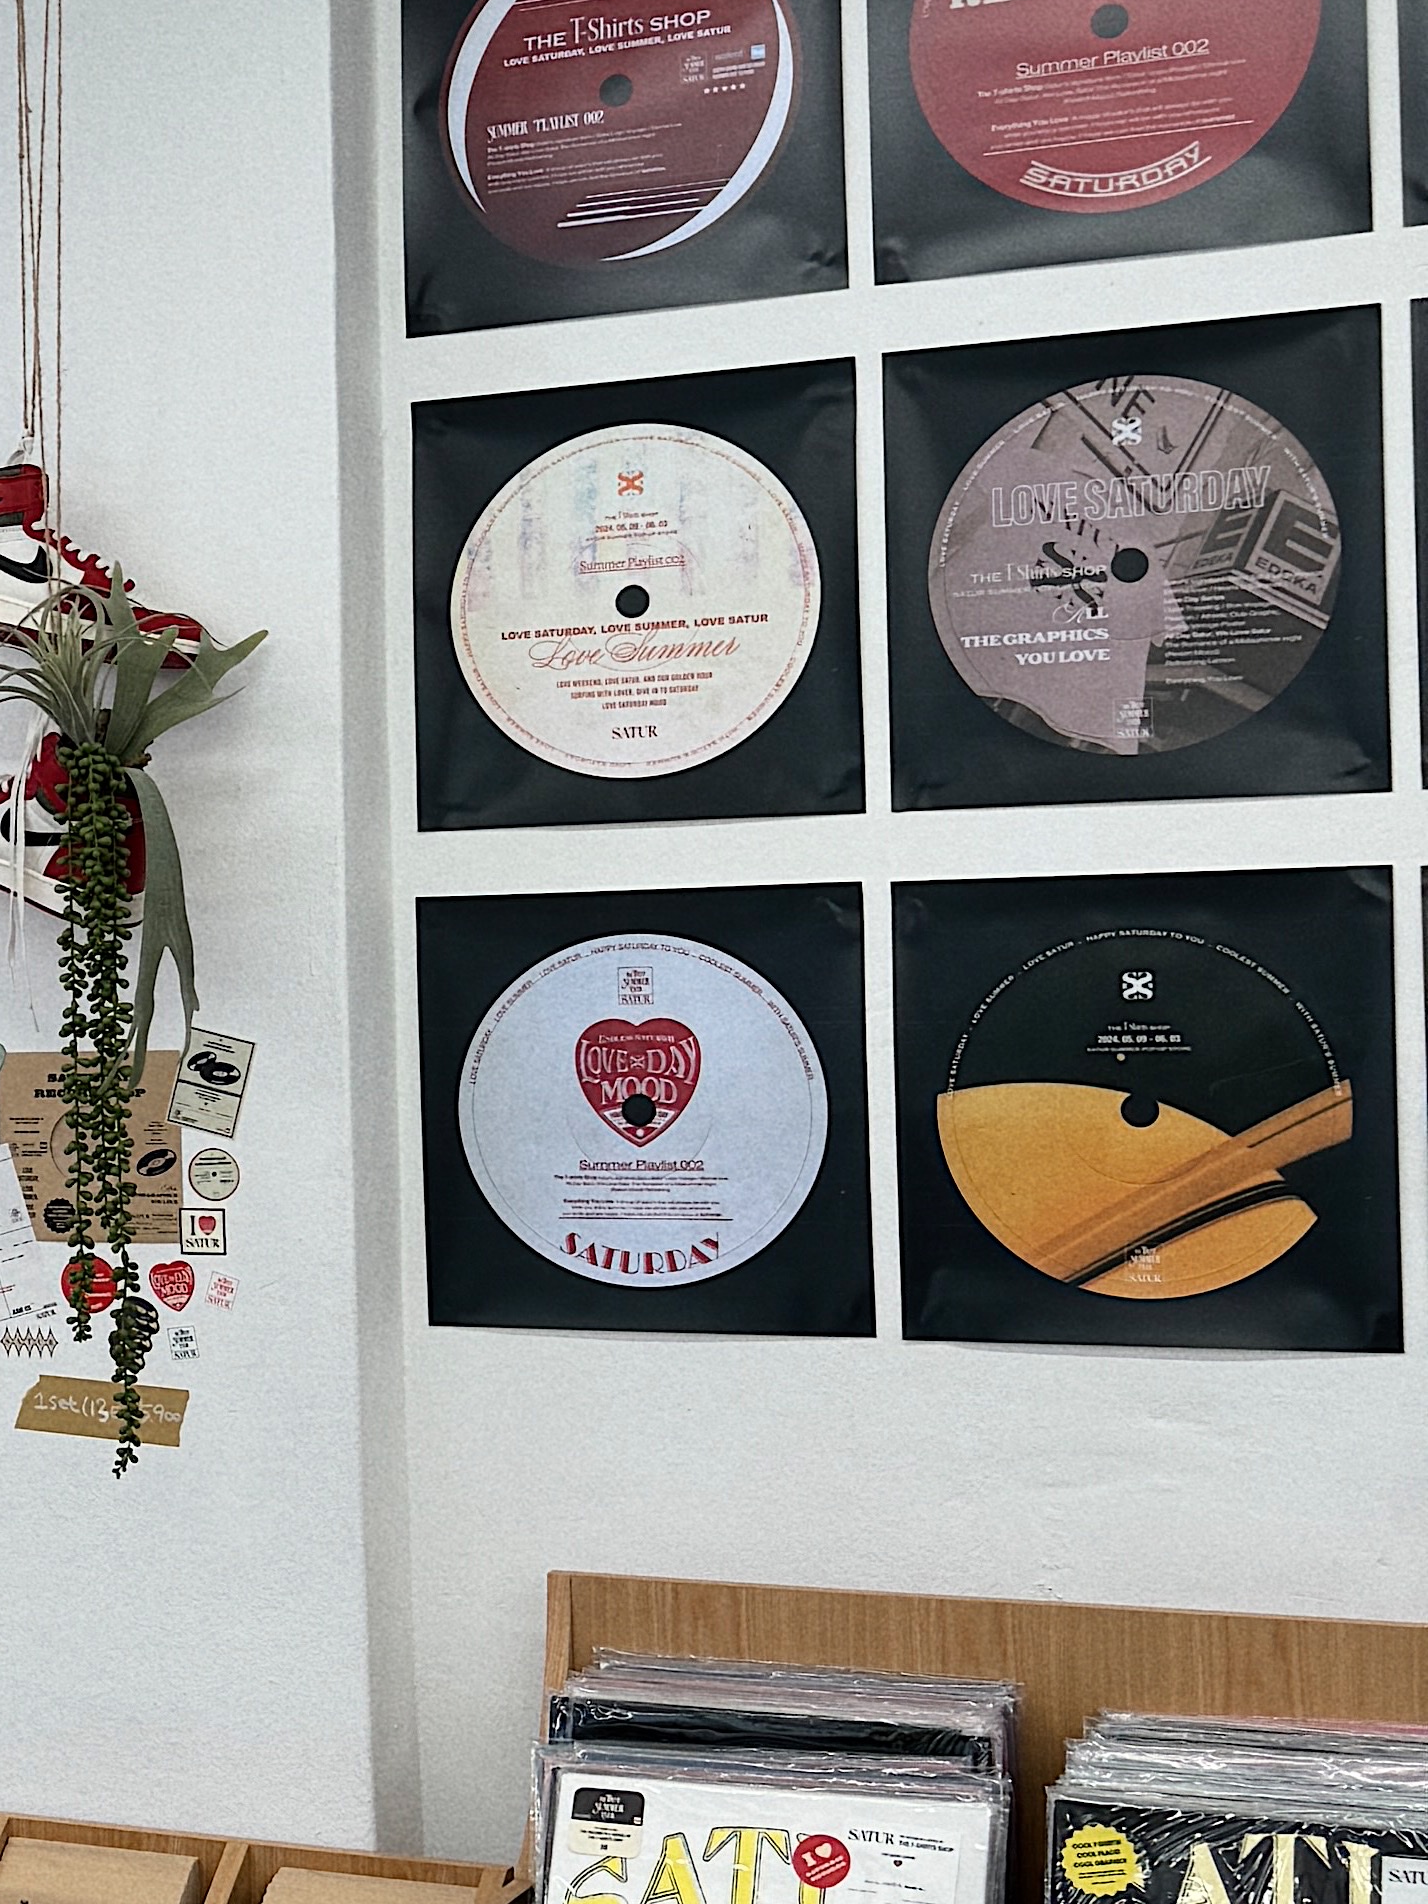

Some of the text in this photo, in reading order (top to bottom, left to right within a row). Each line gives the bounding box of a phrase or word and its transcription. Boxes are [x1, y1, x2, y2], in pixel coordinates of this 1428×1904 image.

[524, 9, 711, 51] THE T-Shirts SHOP
[503, 25, 732, 68] LOVE SATURDAY, LOVE SUMMER, LOVE SATUR
[1016, 38, 1210, 77] Summer Playlist 002
[487, 121, 528, 144] SUMMER
[583, 110, 604, 125] 002
[1022, 143, 1201, 194] SATURDAY
[992, 466, 1271, 527] LOVE SATURDAY
[971, 564, 1108, 583] THE SHOP
[501, 614, 768, 640] LOVE SATURDAY, LOVE SUMMER, LOVE SATUR
[961, 628, 1109, 648] THE GRAPHICS
[529, 629, 740, 672] Love Summer
[1015, 648, 1111, 666] YOU LOVE
[612, 725, 658, 740] SATUR
[1170, 931, 1183, 940] TO
[581, 1037, 697, 1085] LOVE DAY
[601, 1076, 678, 1106] MOOD
[579, 1159, 705, 1172] Summer Playlist 002
[189, 1215, 195, 1236] I
[185, 1237, 220, 1250] SATUR
[560, 1232, 719, 1275] SATURDAY
[848, 1829, 895, 1846] SATUR
